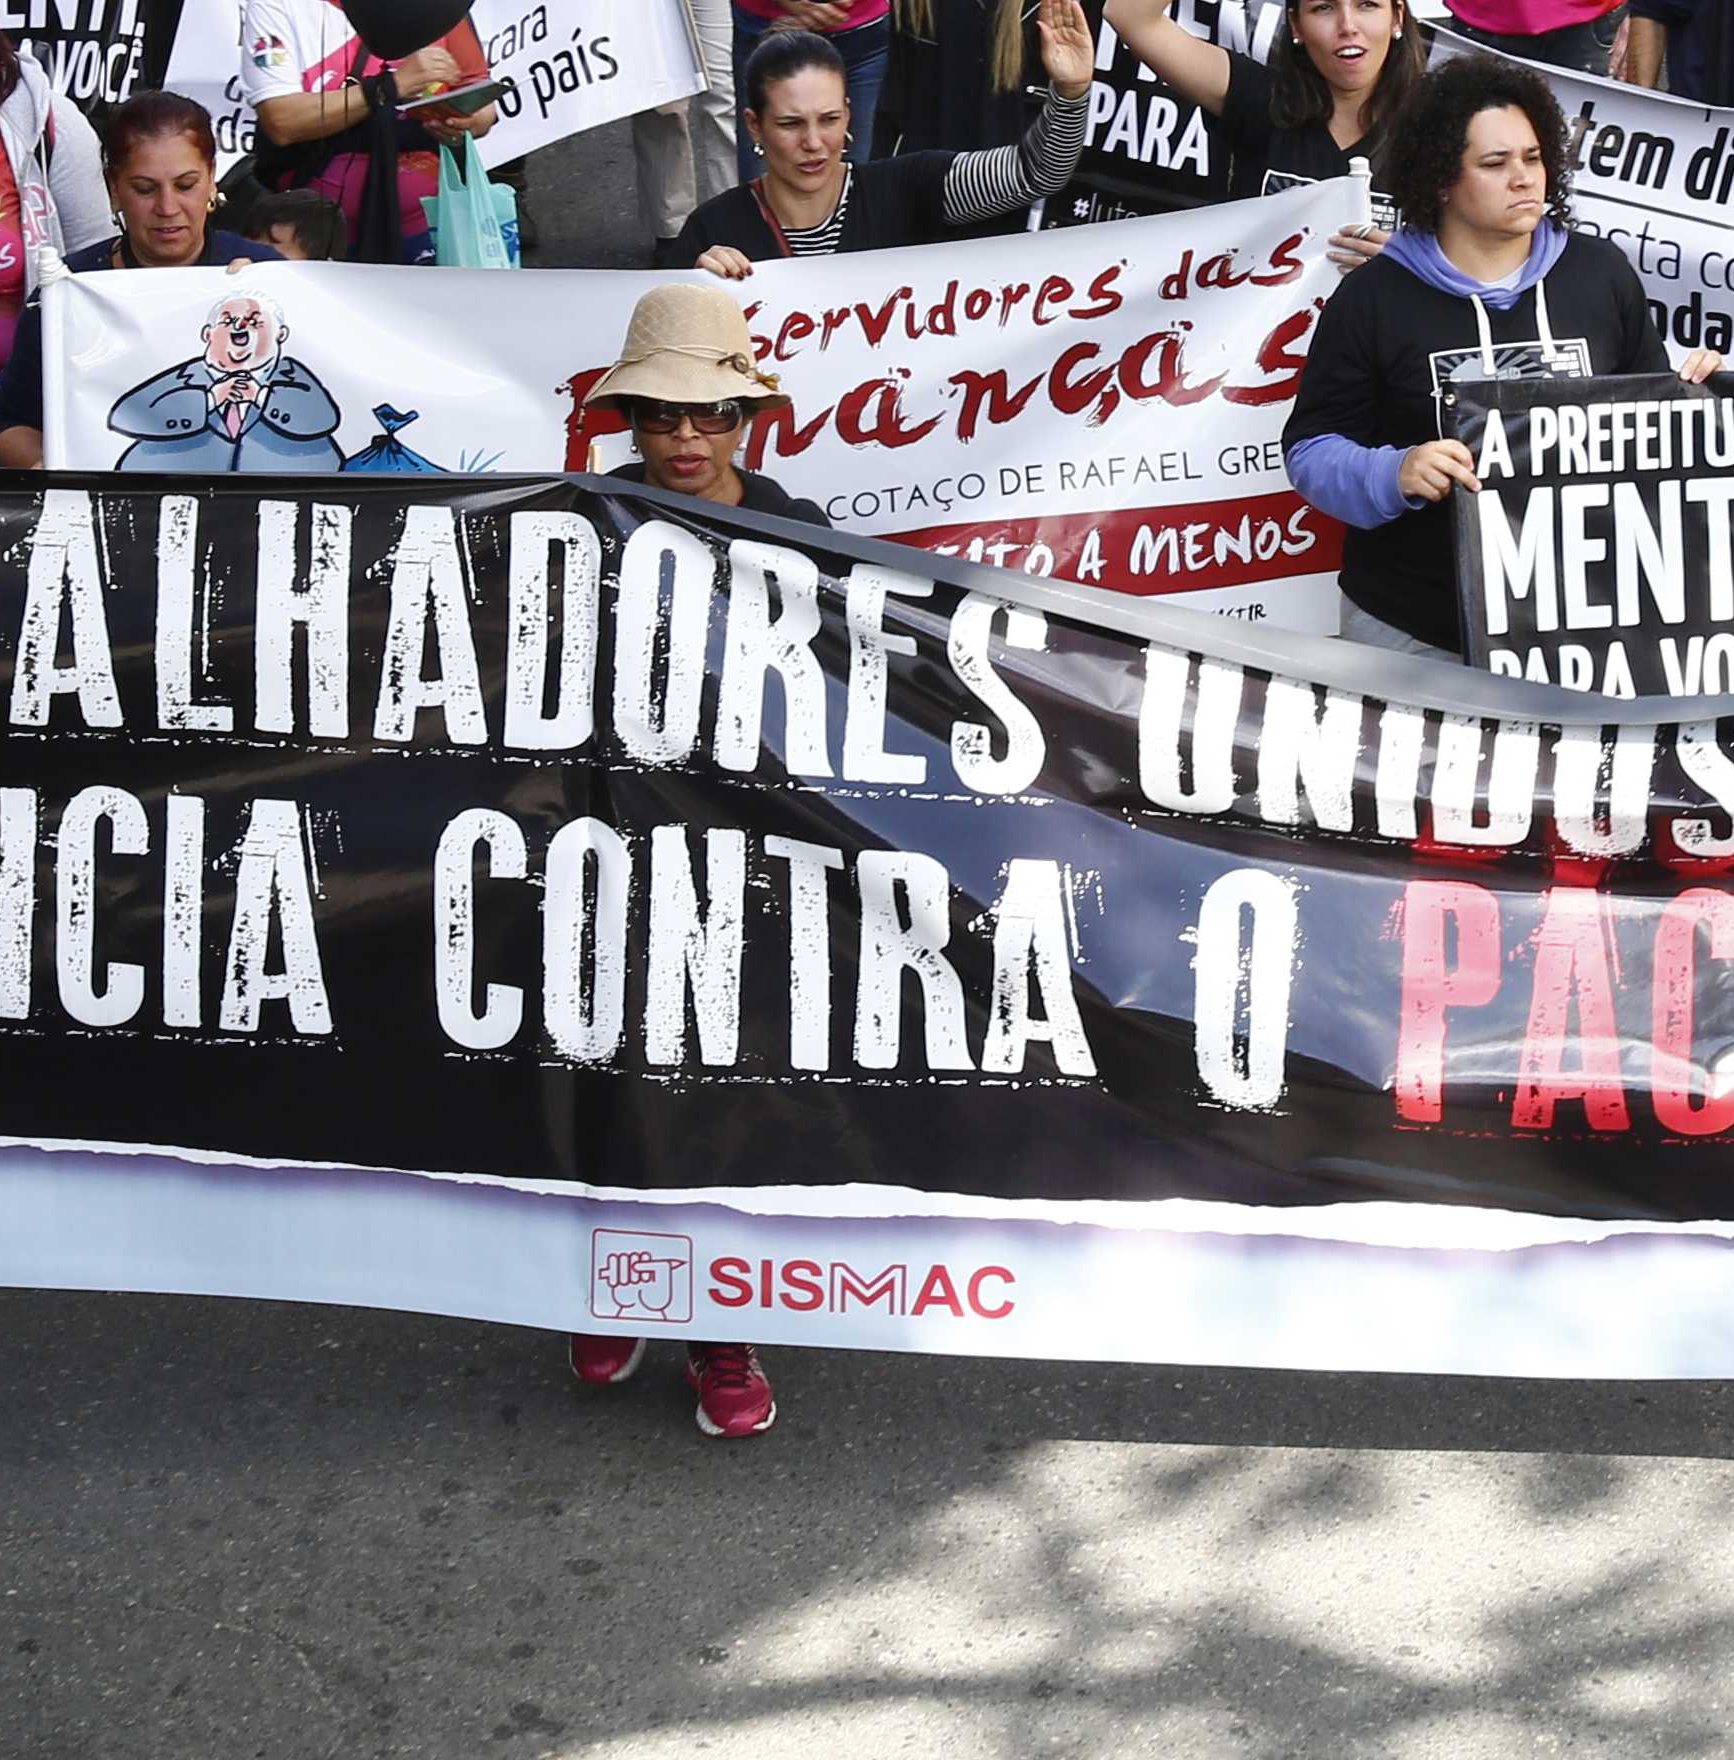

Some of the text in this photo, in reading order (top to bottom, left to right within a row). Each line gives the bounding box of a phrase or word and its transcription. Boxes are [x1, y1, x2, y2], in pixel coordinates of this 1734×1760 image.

[529, 26, 619, 120] país
[1082, 81, 1210, 177] PARA
[1570, 100, 1676, 190] tem
[1157, 225, 1310, 300] das
[999, 463, 1044, 496] DE
[1058, 452, 1203, 491] RAFAEL
[1216, 441, 1284, 476] GRE
[1477, 408, 1516, 479] A
[1076, 505, 1317, 581] A MENOS
[435, 808, 1098, 1079] CONTRA
[1189, 869, 1298, 1110] O
[707, 1256, 1017, 1320] SISMAC
